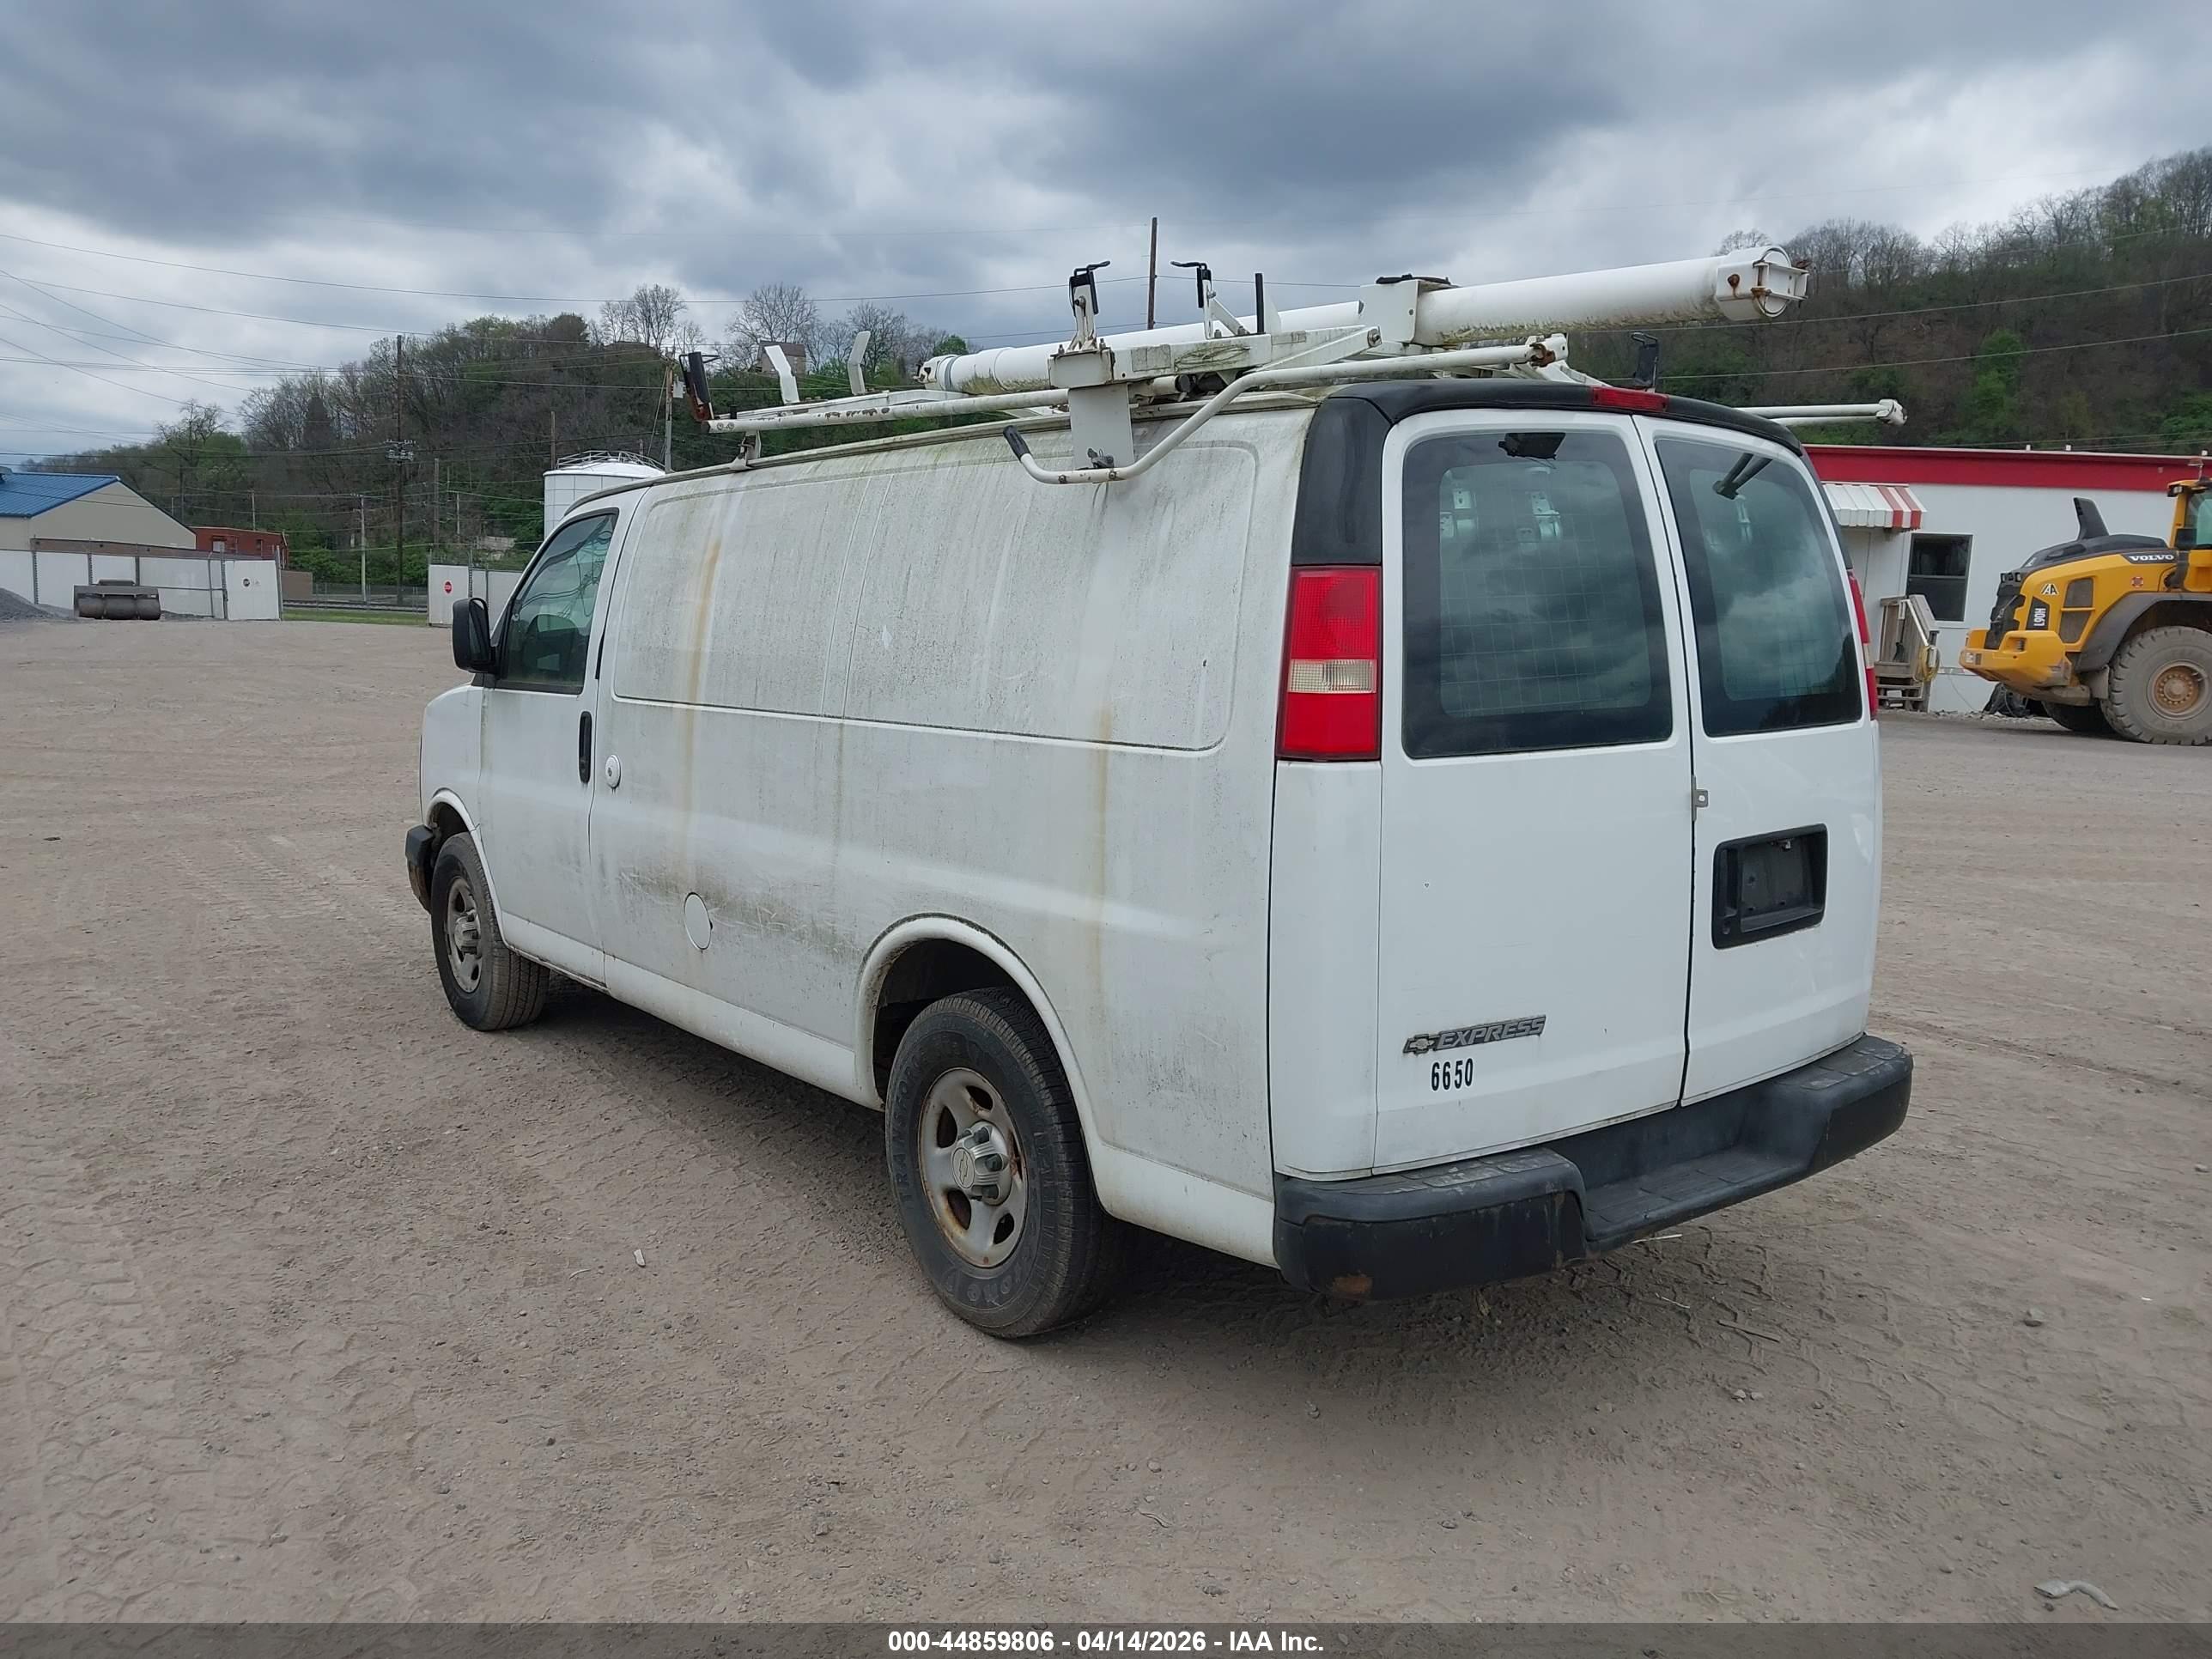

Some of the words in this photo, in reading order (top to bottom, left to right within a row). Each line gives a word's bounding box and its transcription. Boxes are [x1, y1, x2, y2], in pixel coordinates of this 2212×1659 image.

[2033, 607, 2047, 627] L90H
[1436, 1017, 1545, 1049] EXPRESS
[1431, 1057, 1474, 1091] 6650
